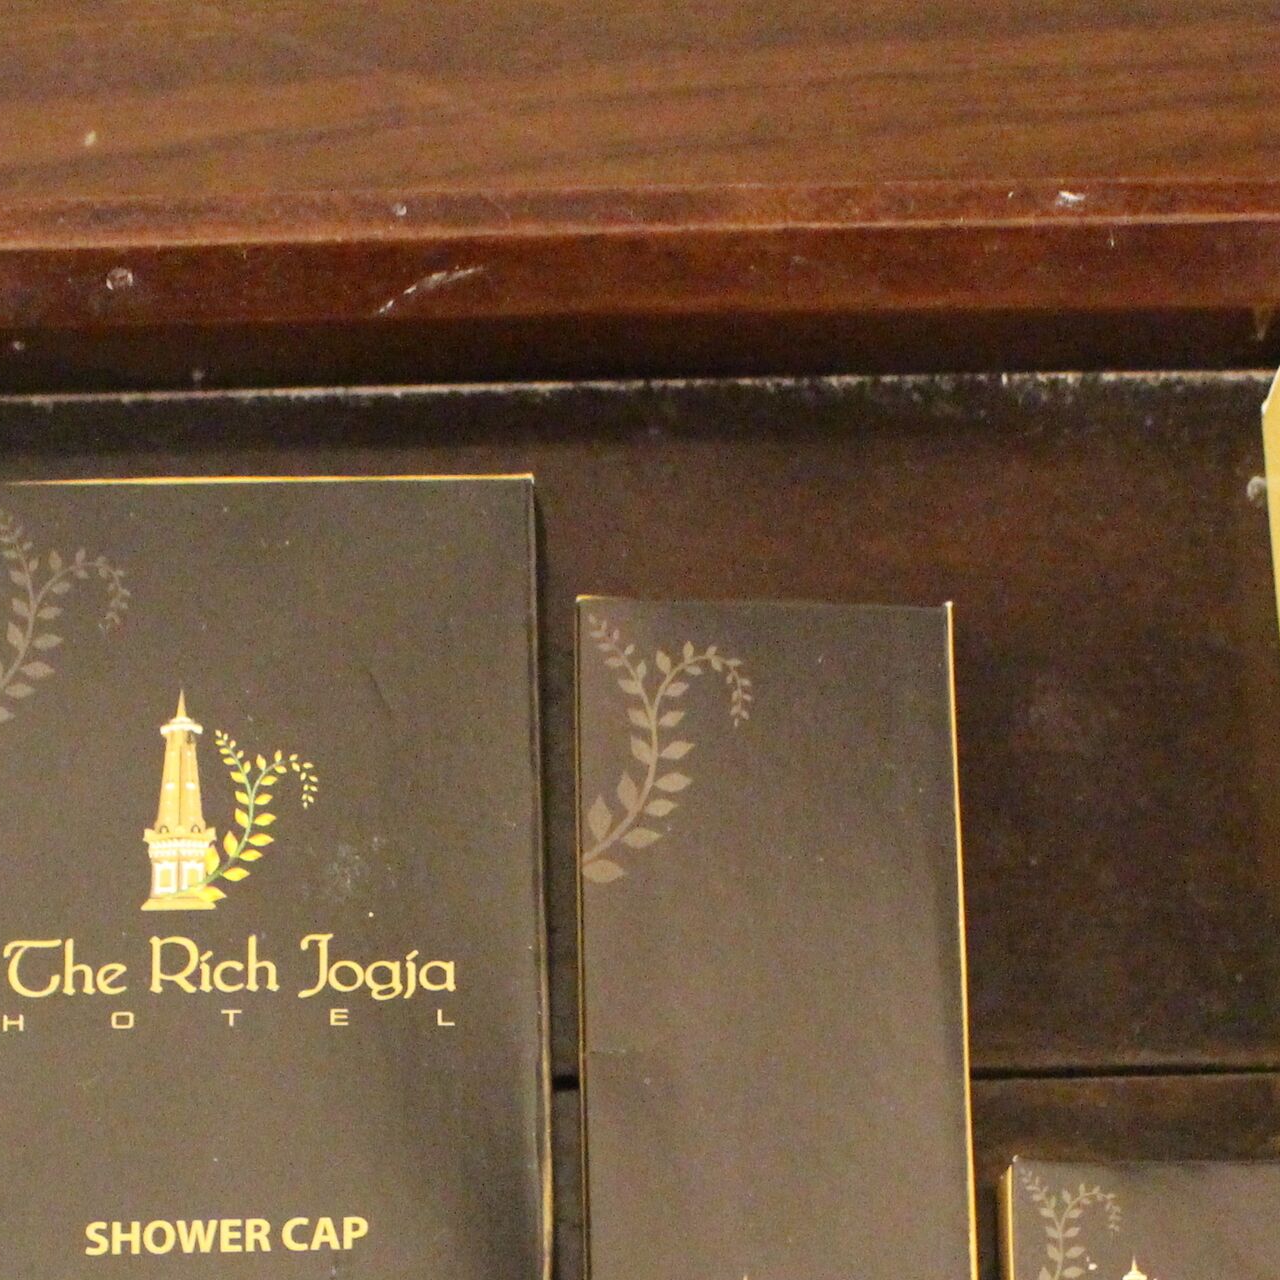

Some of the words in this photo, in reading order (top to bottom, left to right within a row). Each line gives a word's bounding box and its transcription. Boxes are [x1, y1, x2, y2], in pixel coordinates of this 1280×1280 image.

[2, 933, 128, 998] The
[147, 932, 281, 996] Rich
[296, 932, 458, 1001] Jogja
[85, 1218, 272, 1257] SHOWER
[281, 1216, 370, 1252] CAP
